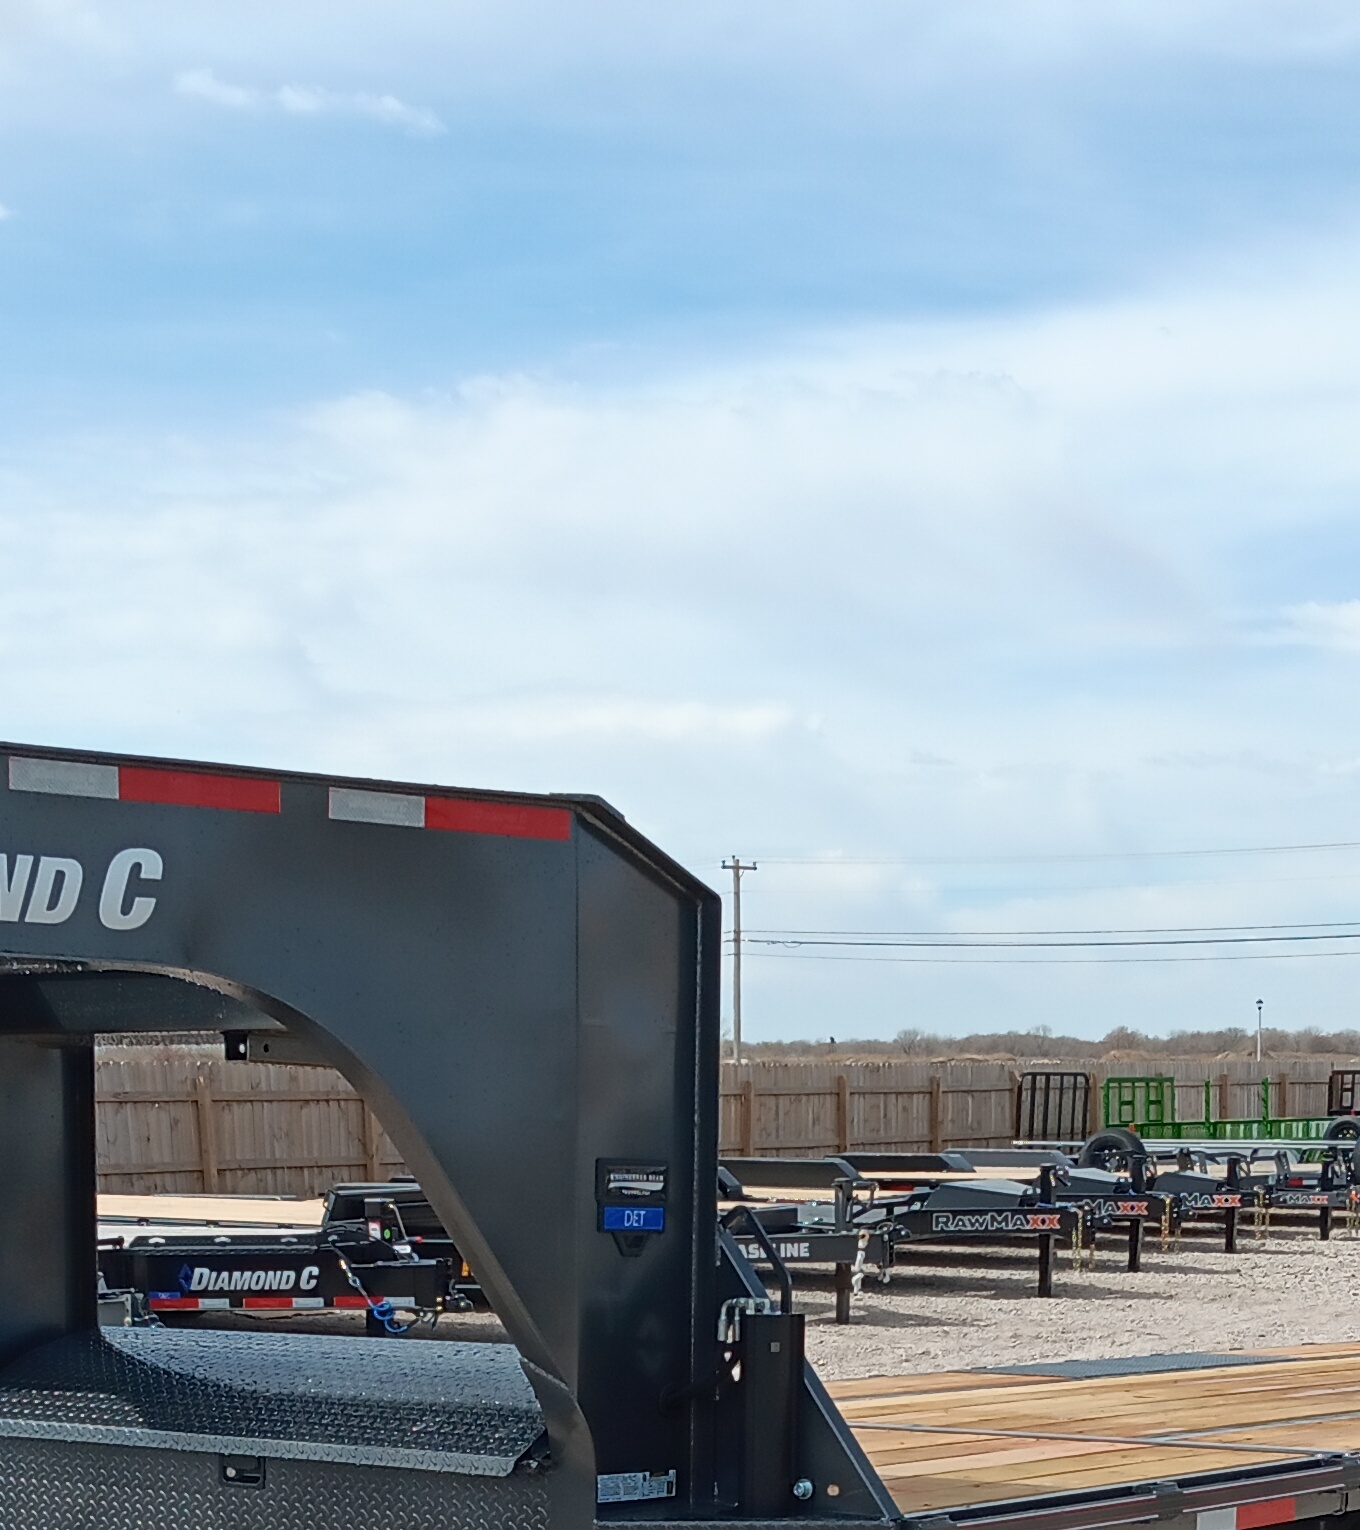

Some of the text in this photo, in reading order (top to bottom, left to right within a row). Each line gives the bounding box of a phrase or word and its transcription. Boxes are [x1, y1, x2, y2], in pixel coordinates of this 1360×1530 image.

[99, 848, 163, 931] C
[624, 1210, 646, 1227] DET
[932, 1212, 1061, 1231] RAWMAXX
[190, 1266, 319, 1291] DIAMOND C
